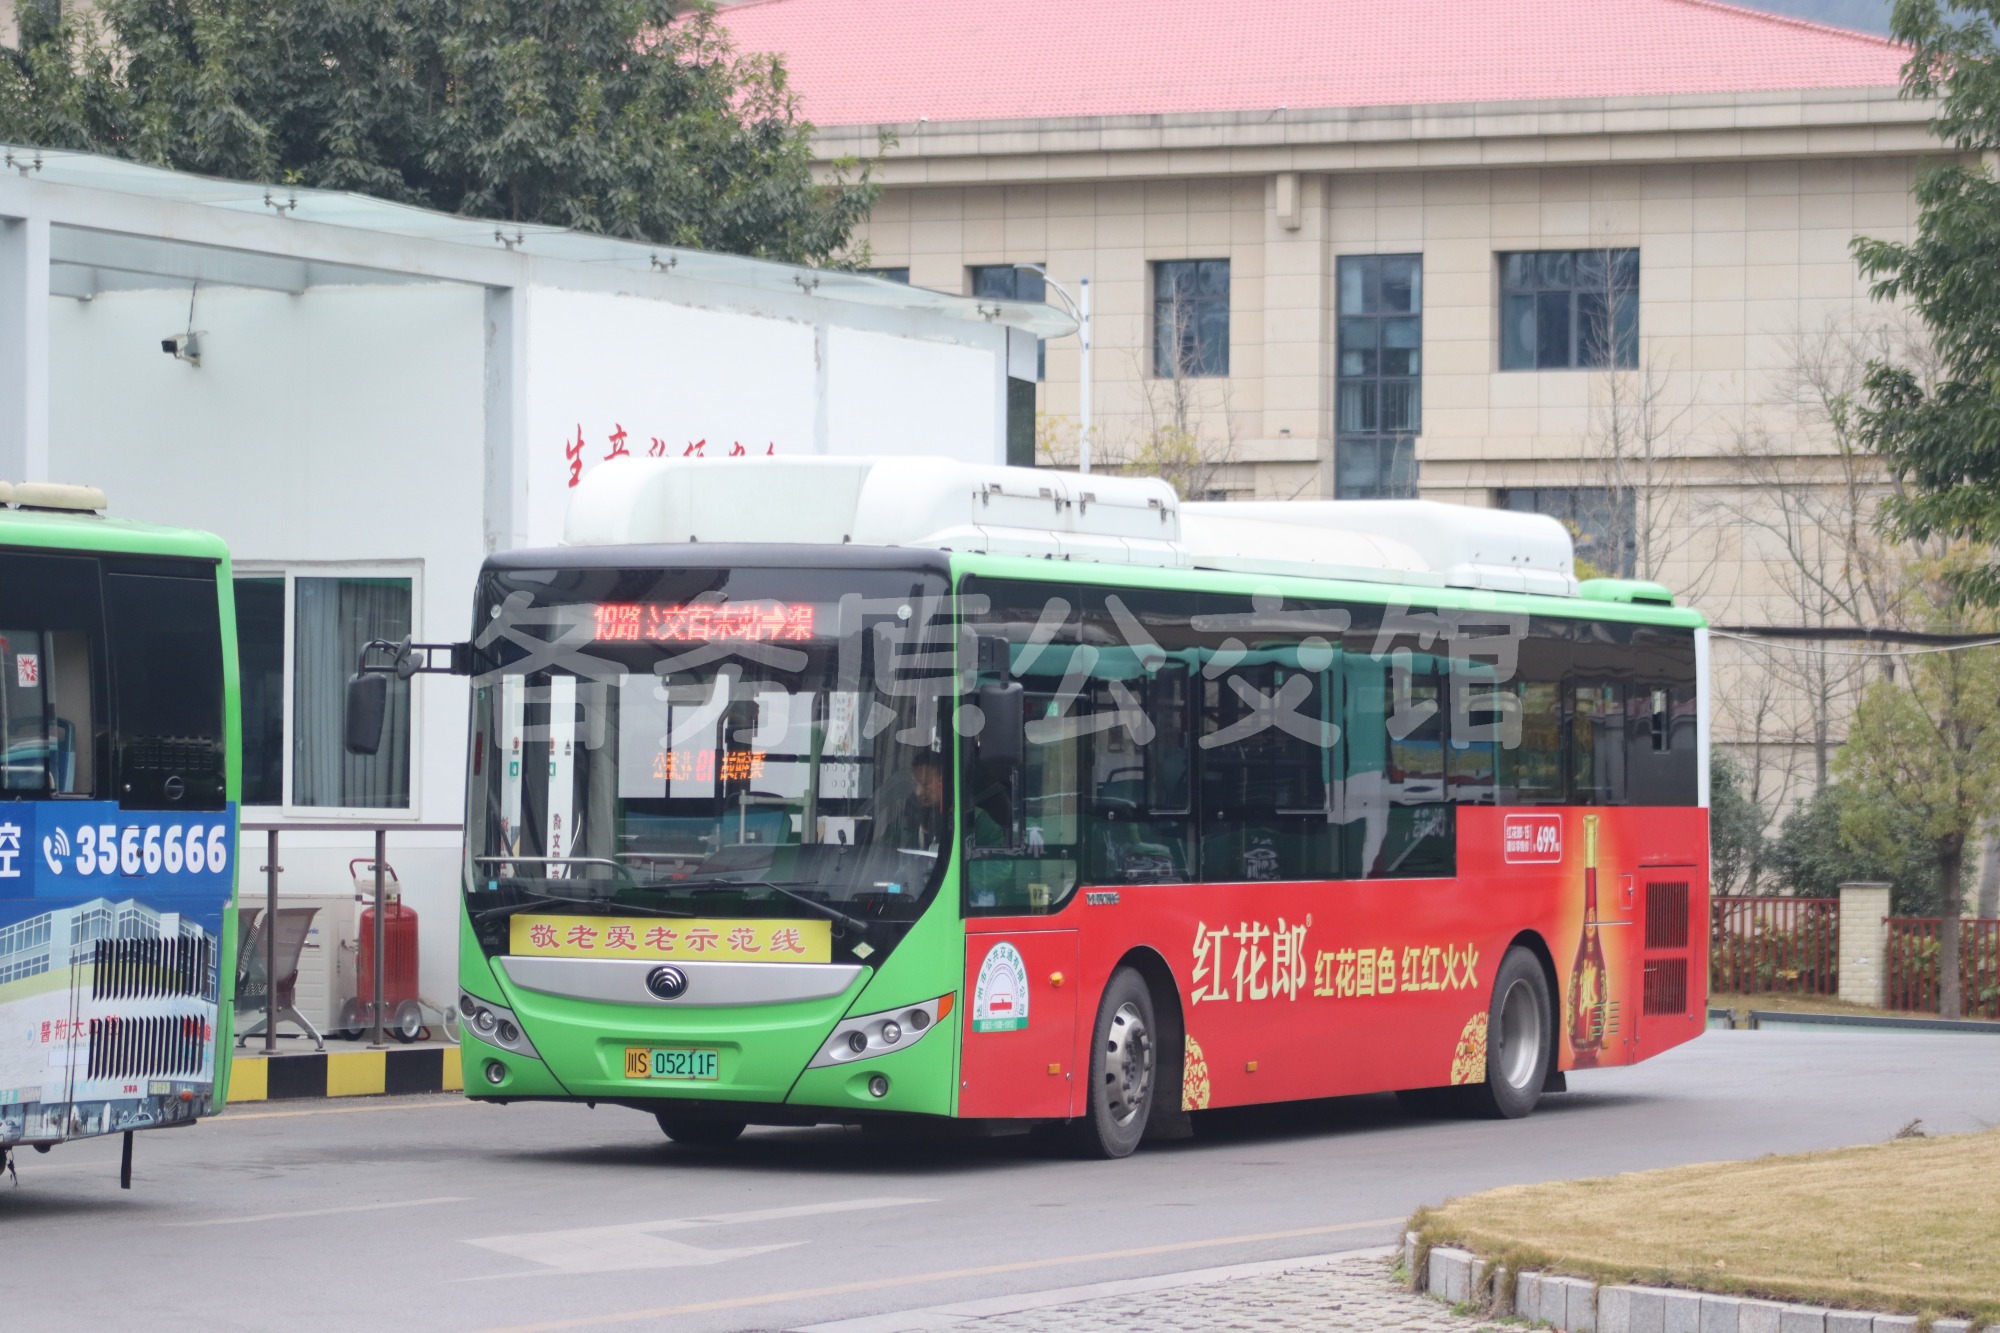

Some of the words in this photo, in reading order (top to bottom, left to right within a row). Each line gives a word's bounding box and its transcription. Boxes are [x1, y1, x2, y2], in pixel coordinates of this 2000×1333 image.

[76, 823, 227, 875] 3566666
[529, 923, 807, 955] 敬老爱老示范线
[1190, 917, 1309, 1006] 红花郎
[1313, 946, 1396, 998] 红花国色
[1401, 942, 1479, 992] 红红火火
[655, 1053, 716, 1075] 05211F
